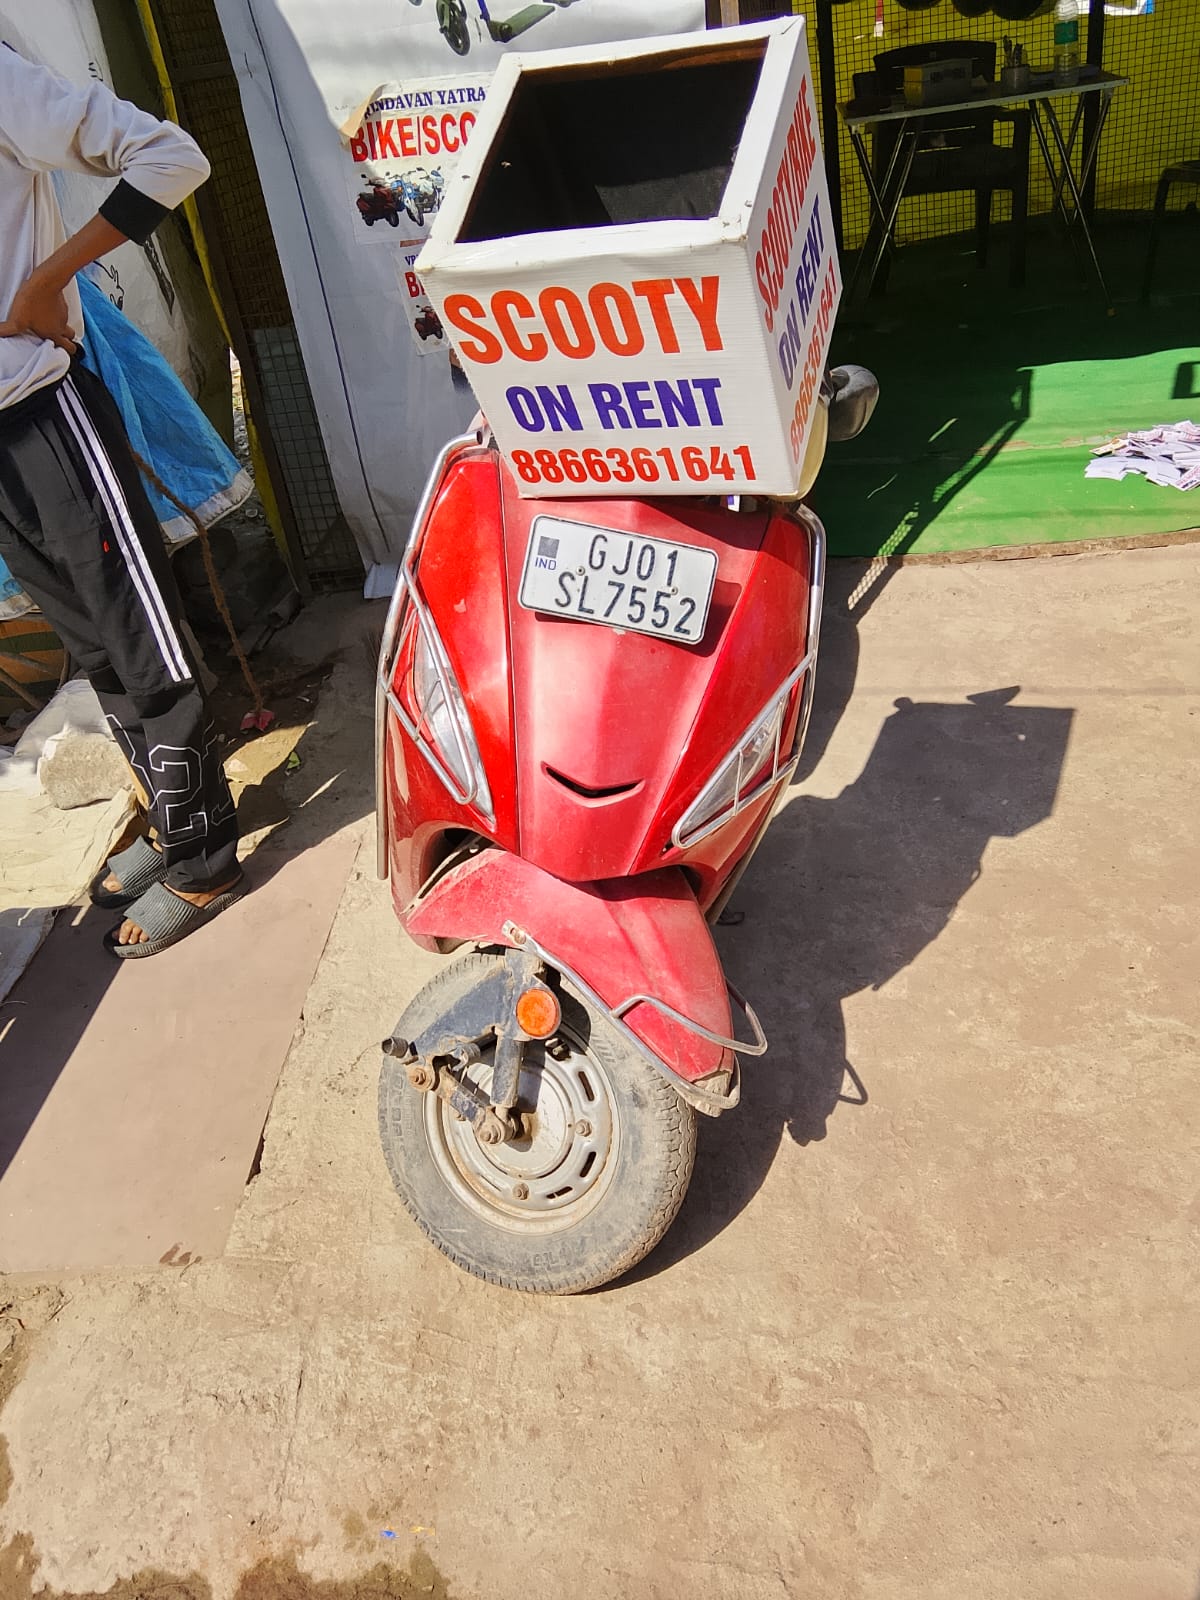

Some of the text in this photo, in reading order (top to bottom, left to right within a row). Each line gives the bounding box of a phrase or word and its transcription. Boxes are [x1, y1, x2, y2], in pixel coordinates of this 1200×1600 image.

[437, 86, 486, 105] YATRA
[755, 74, 816, 333] SCOOTY/BIKE
[443, 275, 724, 364] SCOOTY
[778, 192, 825, 391] ON RENT
[790, 256, 838, 464] 8866361641
[505, 378, 724, 432] ON RENT
[511, 445, 757, 484] 8866361641
[534, 557, 557, 571] IND
[588, 534, 678, 587] GJ01
[555, 571, 696, 636] SL7552
